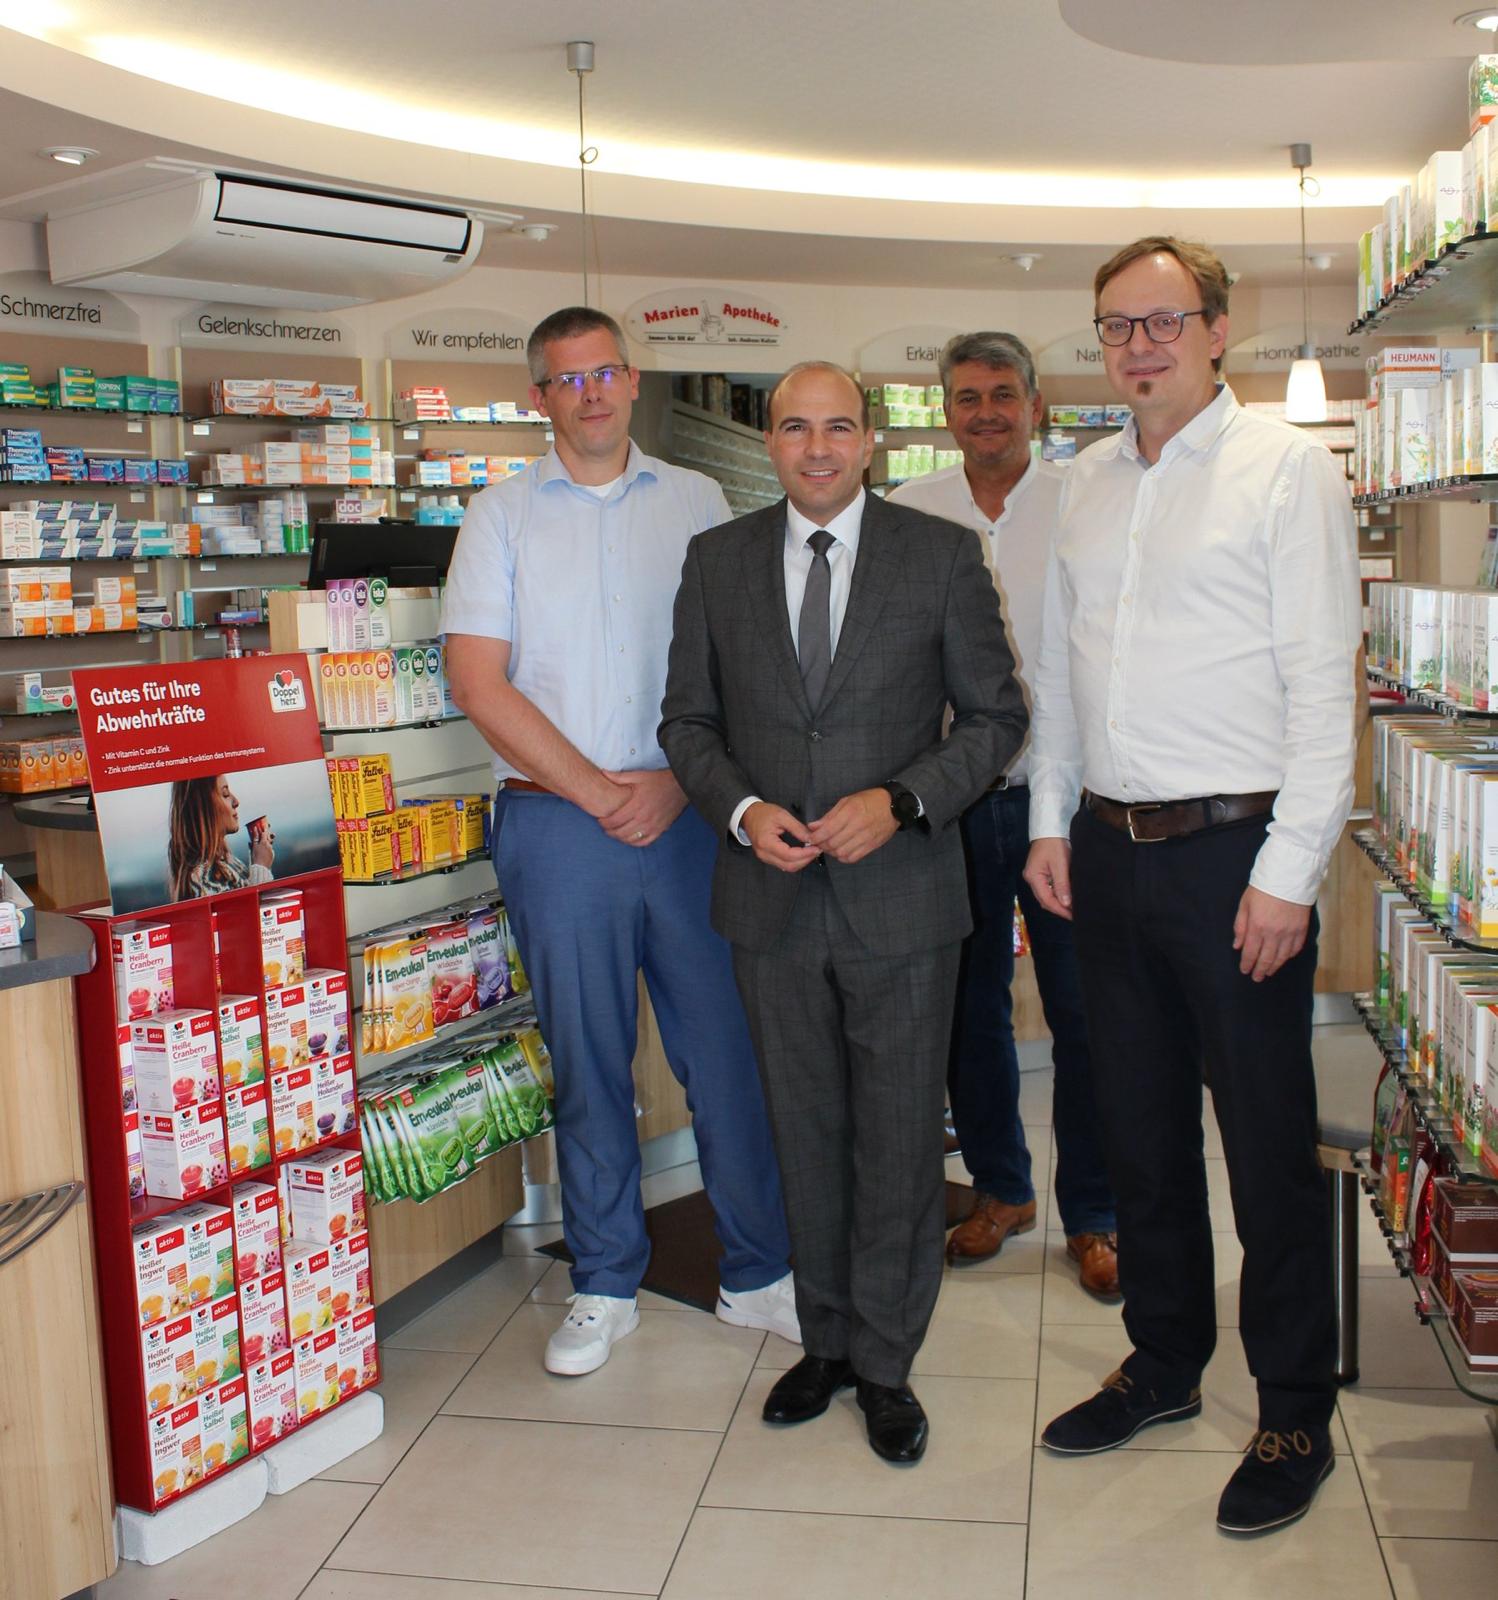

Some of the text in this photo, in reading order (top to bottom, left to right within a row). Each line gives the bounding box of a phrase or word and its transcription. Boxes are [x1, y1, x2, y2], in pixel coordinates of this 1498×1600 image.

[1, 295, 102, 324] Schmerzfrei
[644, 303, 780, 328] Marien Apotheke
[198, 315, 341, 343] Gelenkschmerzen
[411, 329, 524, 353] Wir empfehlen
[1390, 353, 1436, 363] HEUMANN
[338, 502, 362, 513] doc
[90, 680, 201, 706] Gutes für Ihre
[273, 685, 300, 697] Doppel
[280, 698, 297, 706] herz
[96, 704, 206, 734] Abwehrkräfte
[105, 752, 115, 760] Mit
[116, 749, 140, 759] Vitamin
[145, 746, 157, 755] und
[157, 745, 171, 754] Zink
[107, 746, 266, 775] Zink unterstützt die normale Funktion des Immunsystems
[278, 910, 293, 919] aktiv
[151, 932, 168, 942] aktiv
[129, 952, 149, 962] Heiße
[427, 941, 470, 963] Em-eukal
[129, 957, 164, 971] Cranberry
[385, 957, 425, 983] Em-eukal
[329, 980, 344, 989] aktiv
[283, 993, 297, 1002] aktiv
[236, 1006, 251, 1016] aktiv
[194, 1020, 210, 1030] aktiv
[171, 1041, 192, 1051] Heiße
[172, 1044, 208, 1060] Cranberry
[289, 1075, 304, 1085] aktiv
[243, 1091, 258, 1101] aktiv
[202, 1107, 218, 1117] aktiv
[273, 1100, 296, 1113] Ingwer
[408, 1094, 450, 1127] Em-eukal
[179, 1128, 199, 1140] Heiße
[180, 1131, 215, 1148] Cranberry
[258, 1196, 274, 1207] aktiv
[208, 1219, 224, 1231] aktiv
[237, 1219, 256, 1230] Heiße
[237, 1219, 271, 1237] Cranberry
[158, 1236, 175, 1248] aktiv
[189, 1241, 211, 1253] Heißer
[190, 1249, 211, 1261] Salbei
[139, 1258, 163, 1272] Heißer
[332, 1258, 367, 1278] Granatapfel
[139, 1265, 166, 1280] Ingwer
[264, 1278, 280, 1289] aktiv
[213, 1303, 229, 1315] aktiv
[243, 1300, 262, 1313] Heiße
[244, 1302, 277, 1320] Cranberry
[167, 1324, 183, 1336] aktiv
[196, 1333, 217, 1346] Salbei
[147, 1346, 171, 1361] Heißer
[148, 1353, 174, 1369] Ingwer
[274, 1359, 290, 1371] aktiv
[221, 1386, 237, 1398] aktiv
[253, 1382, 273, 1395] Heiße
[254, 1383, 287, 1403] Cranberry
[174, 1410, 190, 1422] aktiv
[203, 1416, 225, 1430] Salbei
[154, 1433, 178, 1447] Heißer
[154, 1438, 181, 1456] Ingwer
